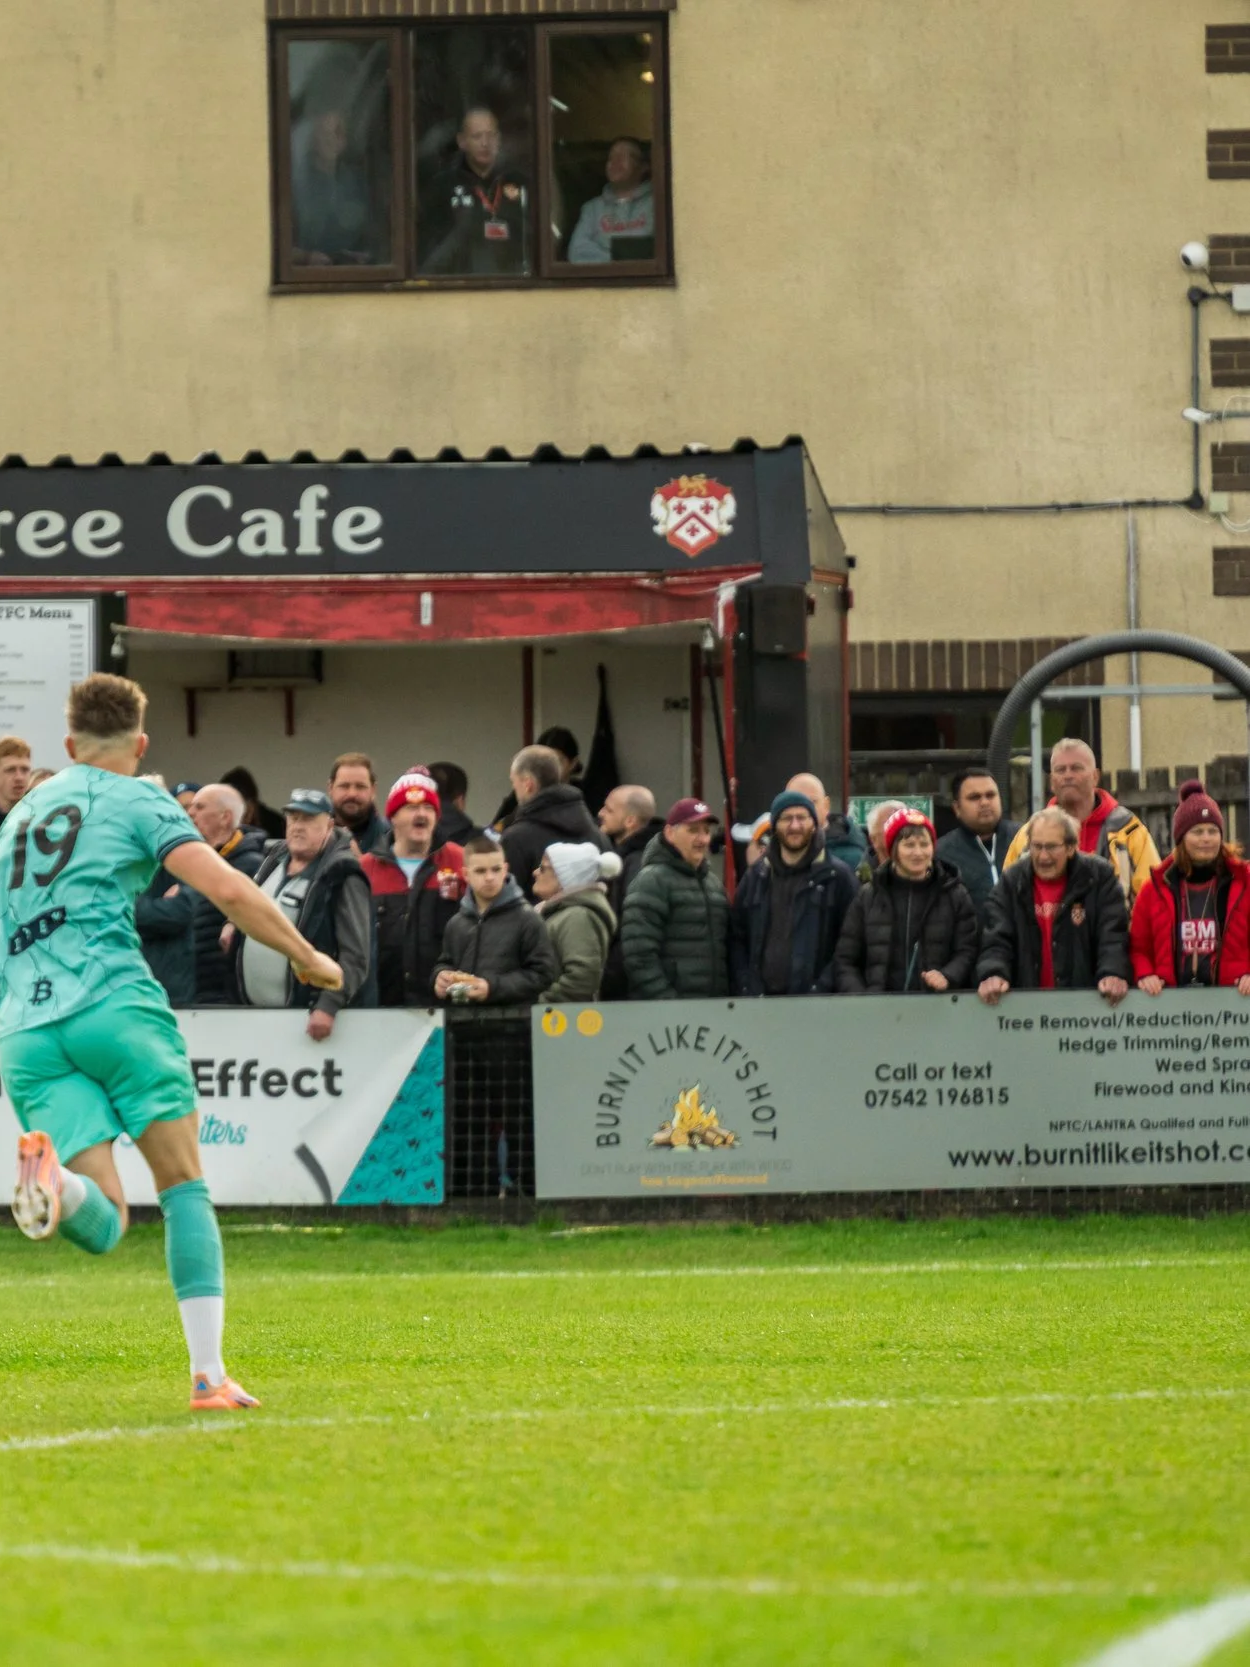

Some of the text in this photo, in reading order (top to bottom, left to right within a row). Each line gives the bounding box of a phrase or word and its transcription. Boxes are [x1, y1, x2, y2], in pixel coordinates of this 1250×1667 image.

[166, 484, 383, 558] Cafe
[29, 606, 73, 619] Menu
[8, 804, 82, 888] 19
[1181, 920, 1215, 940] BM
[997, 1015, 1034, 1031] Tree
[1059, 1036, 1118, 1054] Hedge
[875, 1061, 993, 1083] Call or text
[1155, 1057, 1207, 1073] Weed
[193, 1058, 343, 1098] Effect
[596, 1024, 777, 1148] BURN IT LIKE IT'S HOT
[1095, 1080, 1174, 1097] Firewood
[1180, 1079, 1215, 1095] and
[865, 1086, 1010, 1108] 07542 196815
[1199, 1116, 1225, 1129] and
